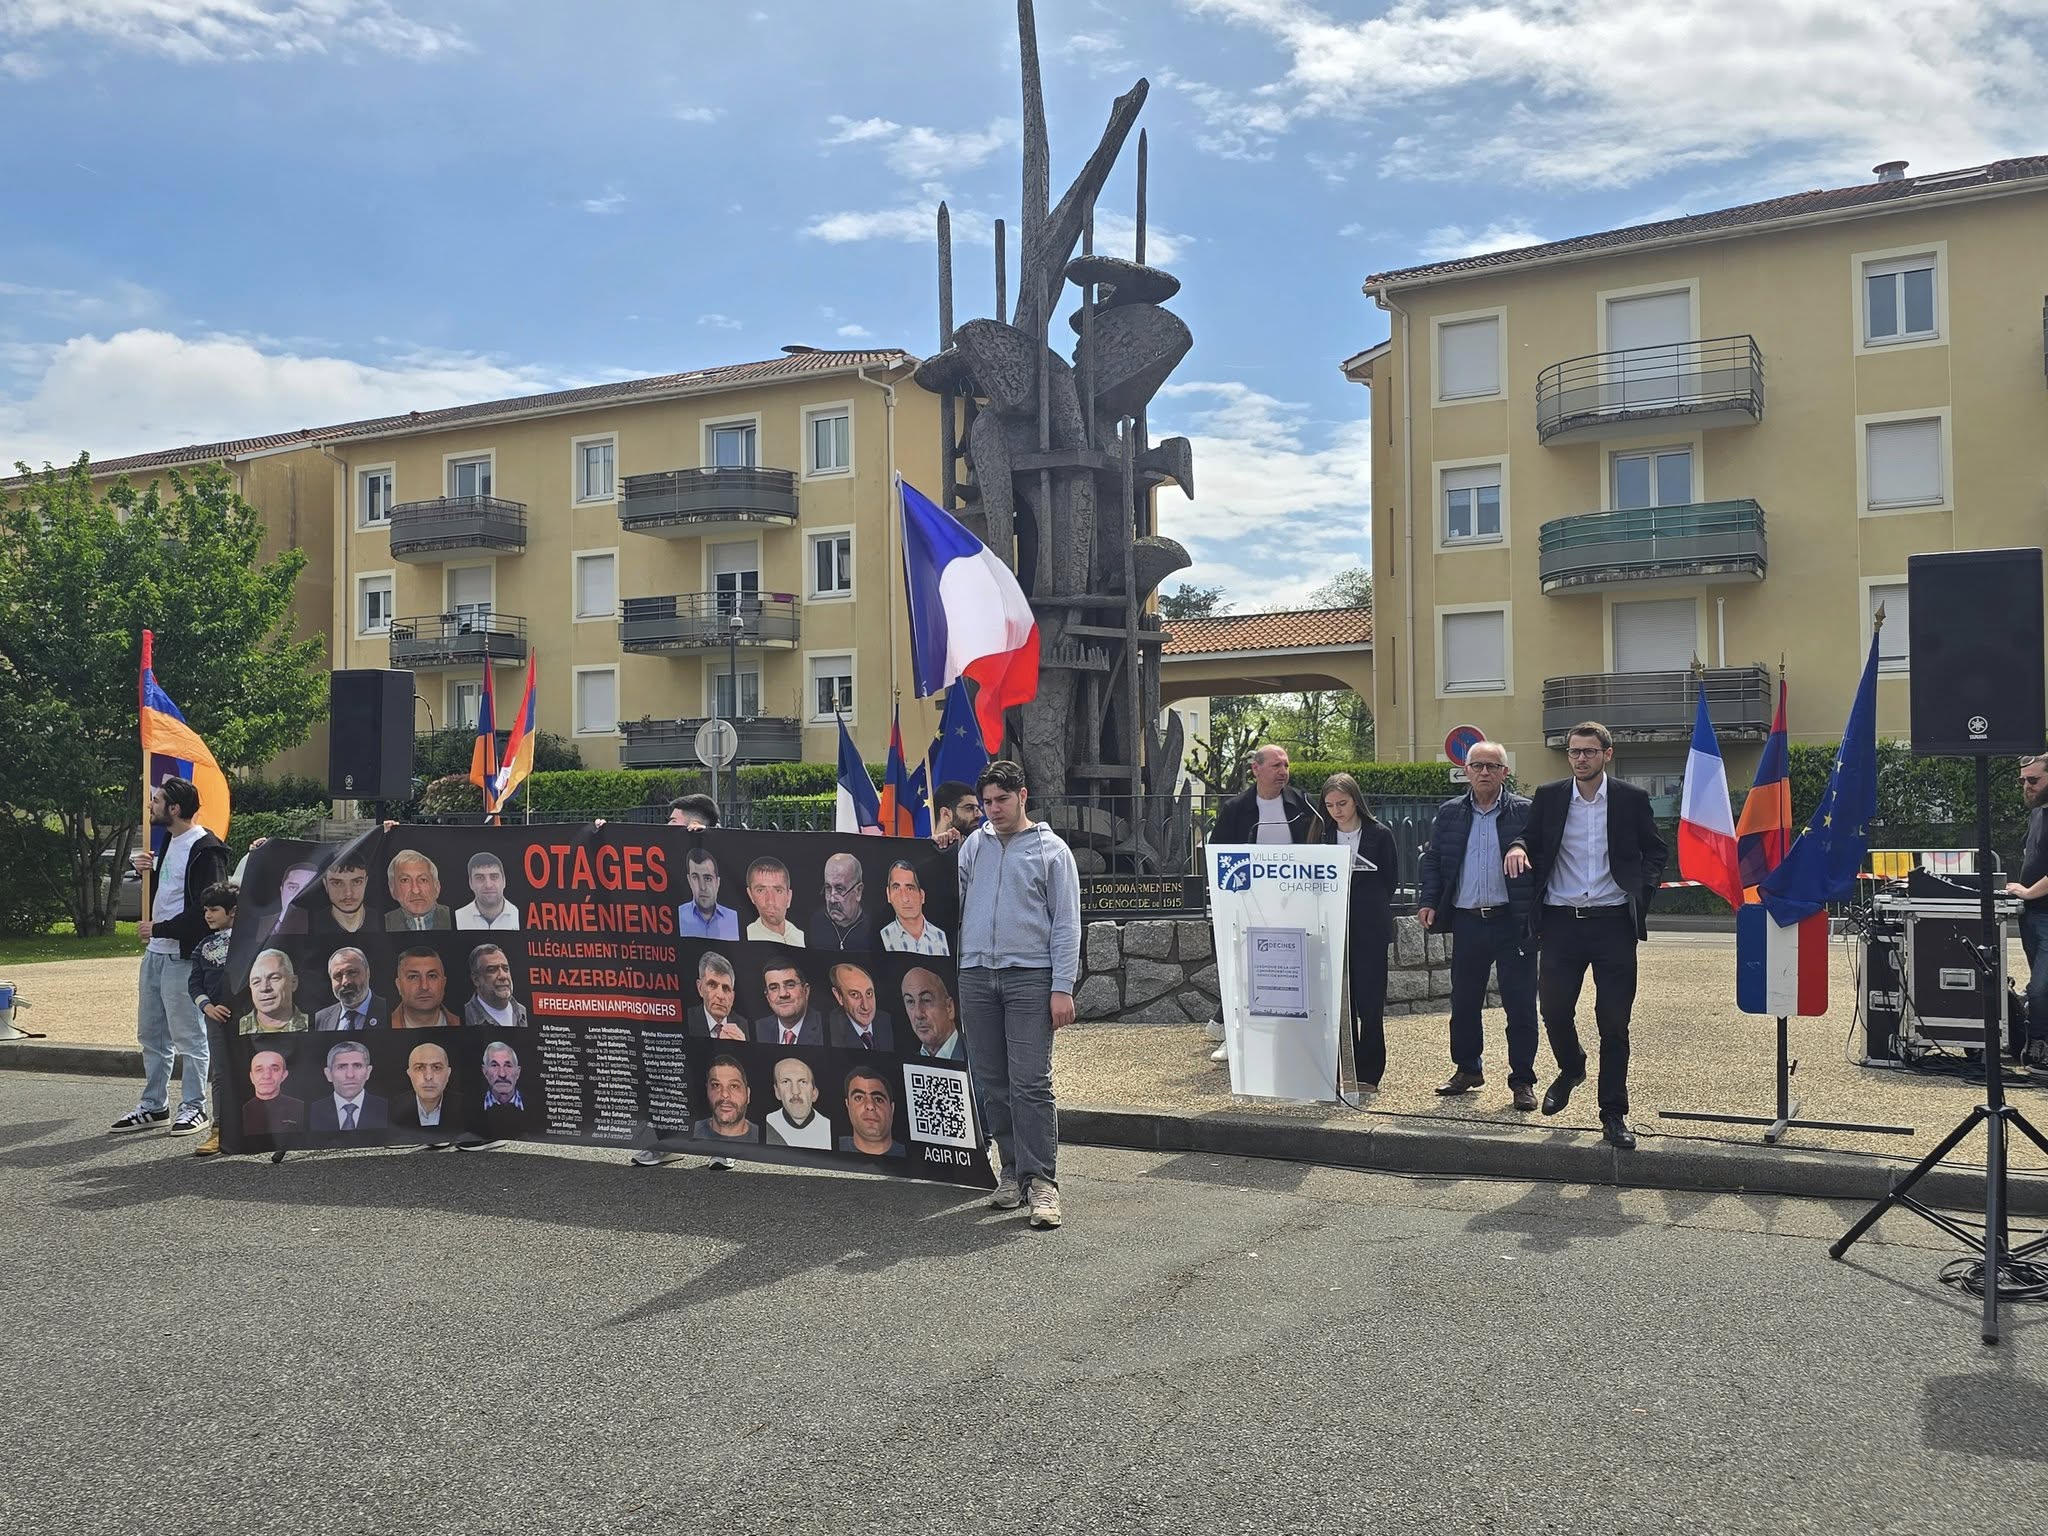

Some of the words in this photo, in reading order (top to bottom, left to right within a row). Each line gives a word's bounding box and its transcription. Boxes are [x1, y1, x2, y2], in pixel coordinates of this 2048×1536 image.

[1253, 853, 1280, 861] VILLE
[524, 844, 668, 892] OTAGES
[1253, 864, 1337, 879] DECINES
[1280, 882, 1338, 892] CHARPIEU
[1099, 898, 1150, 909] GENOCDE
[1163, 898, 1182, 907] 1915
[526, 895, 673, 934] ARMÉNIENS
[528, 938, 618, 958] ILLÉGALEMENT
[621, 941, 676, 962] DÉTENUS
[530, 968, 551, 984] EN
[558, 968, 679, 991] AZERBAÏDJAN
[539, 998, 676, 1016] #FREEARMENIANPRISONERS
[925, 1147, 952, 1163] AGIR
[955, 1151, 971, 1166] ICI
